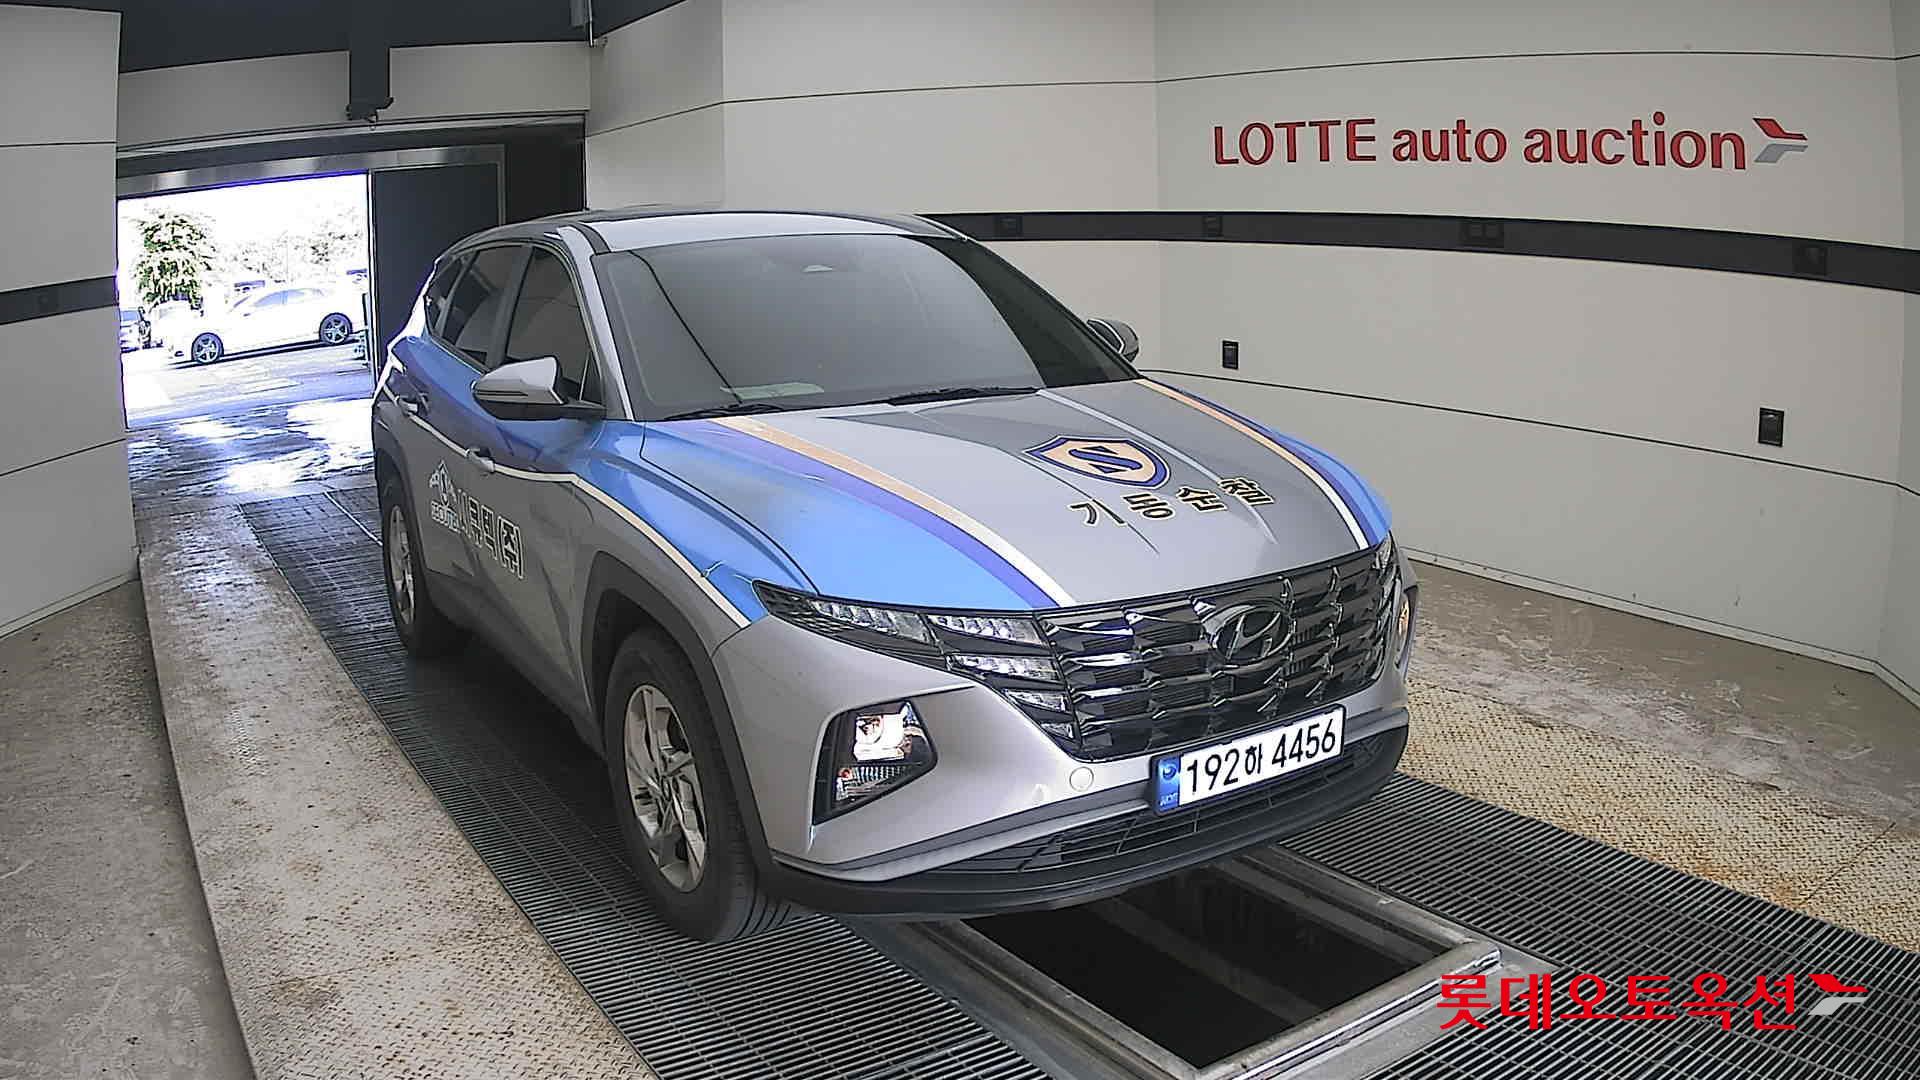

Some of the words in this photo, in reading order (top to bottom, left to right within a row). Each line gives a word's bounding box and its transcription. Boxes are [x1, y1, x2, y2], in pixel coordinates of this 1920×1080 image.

[1214, 118, 1376, 165] LOTTE
[1392, 119, 1507, 163] auto
[1523, 111, 1746, 170] auction
[1069, 477, 1276, 526] 기동순찰
[1186, 743, 1263, 793] 192하
[1271, 718, 1336, 768] 4456
